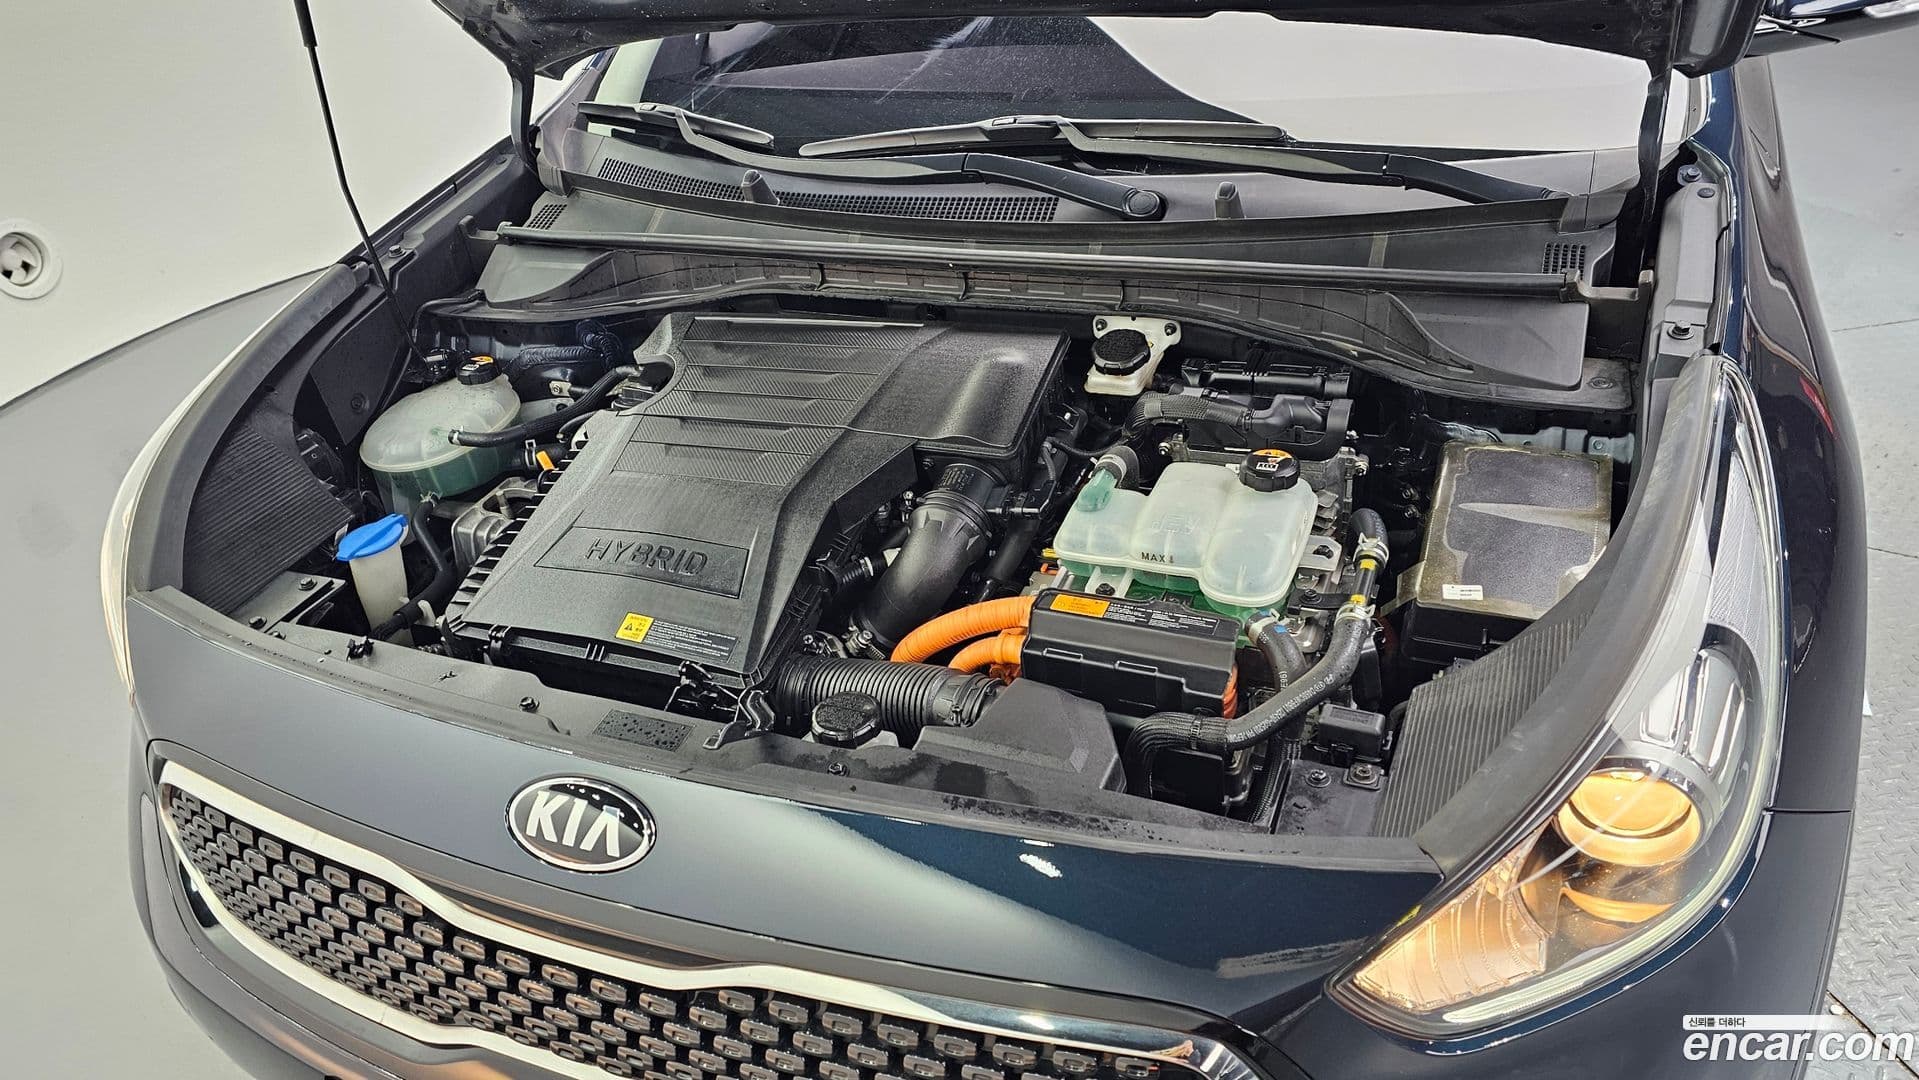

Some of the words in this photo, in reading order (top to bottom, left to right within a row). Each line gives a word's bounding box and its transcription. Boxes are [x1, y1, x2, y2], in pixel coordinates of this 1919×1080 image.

[584, 538, 708, 575] HYBRID
[1141, 551, 1166, 563] MAX
[525, 790, 620, 858] KIA
